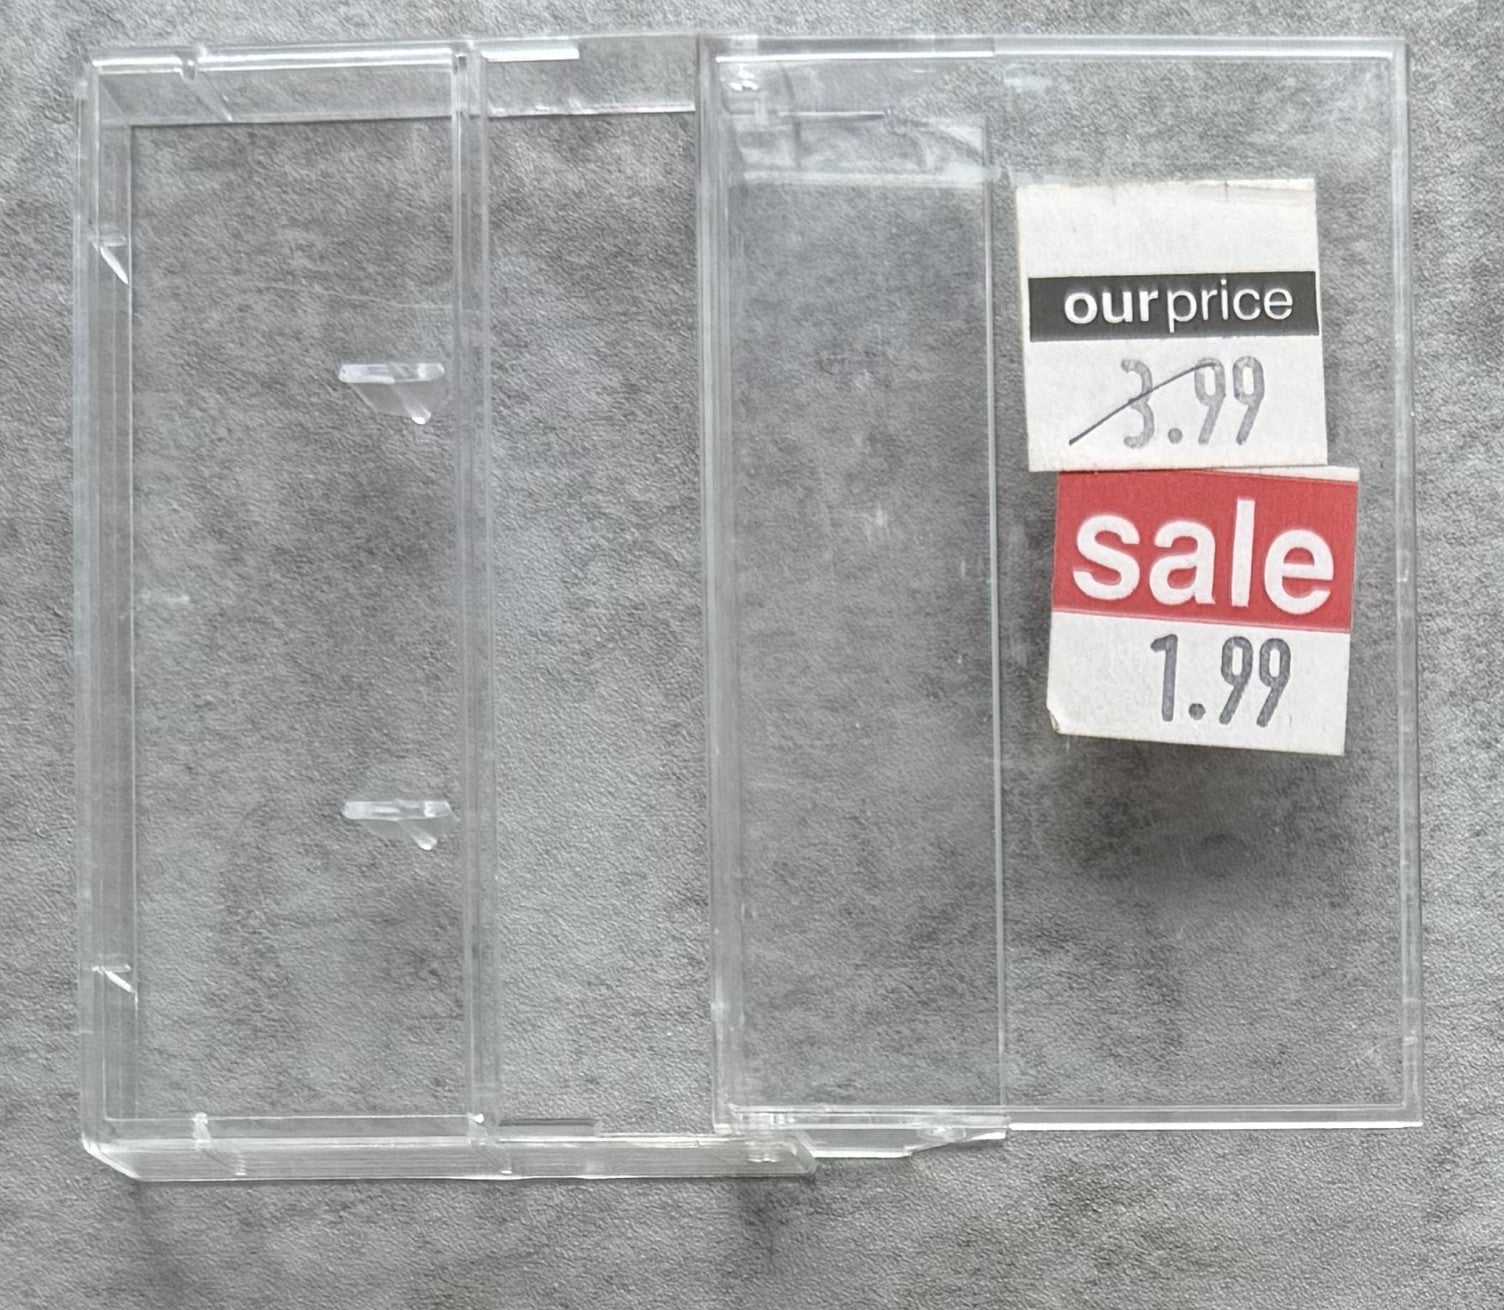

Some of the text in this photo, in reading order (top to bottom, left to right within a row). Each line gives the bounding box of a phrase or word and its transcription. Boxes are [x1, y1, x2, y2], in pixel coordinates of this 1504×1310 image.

[1119, 356, 1267, 449] 3.99
[1071, 497, 1336, 615] sale
[1150, 632, 1292, 728] 1.99
